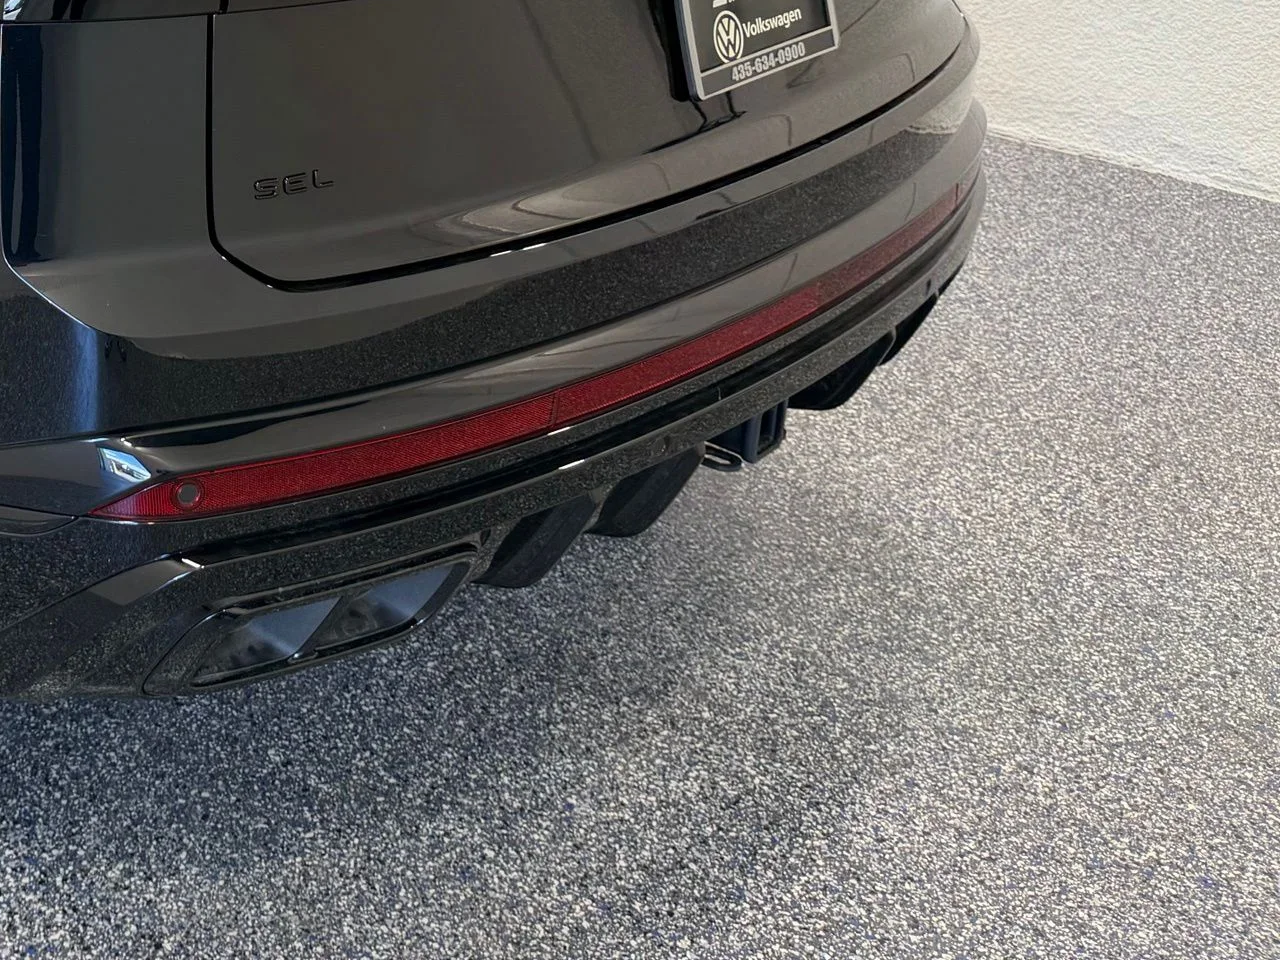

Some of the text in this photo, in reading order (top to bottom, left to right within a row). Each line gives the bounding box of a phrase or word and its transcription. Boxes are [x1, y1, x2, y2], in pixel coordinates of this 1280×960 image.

[742, 8, 802, 38] Volkswagen
[731, 41, 806, 81] 435-634-0900
[253, 169, 334, 200] SEL
